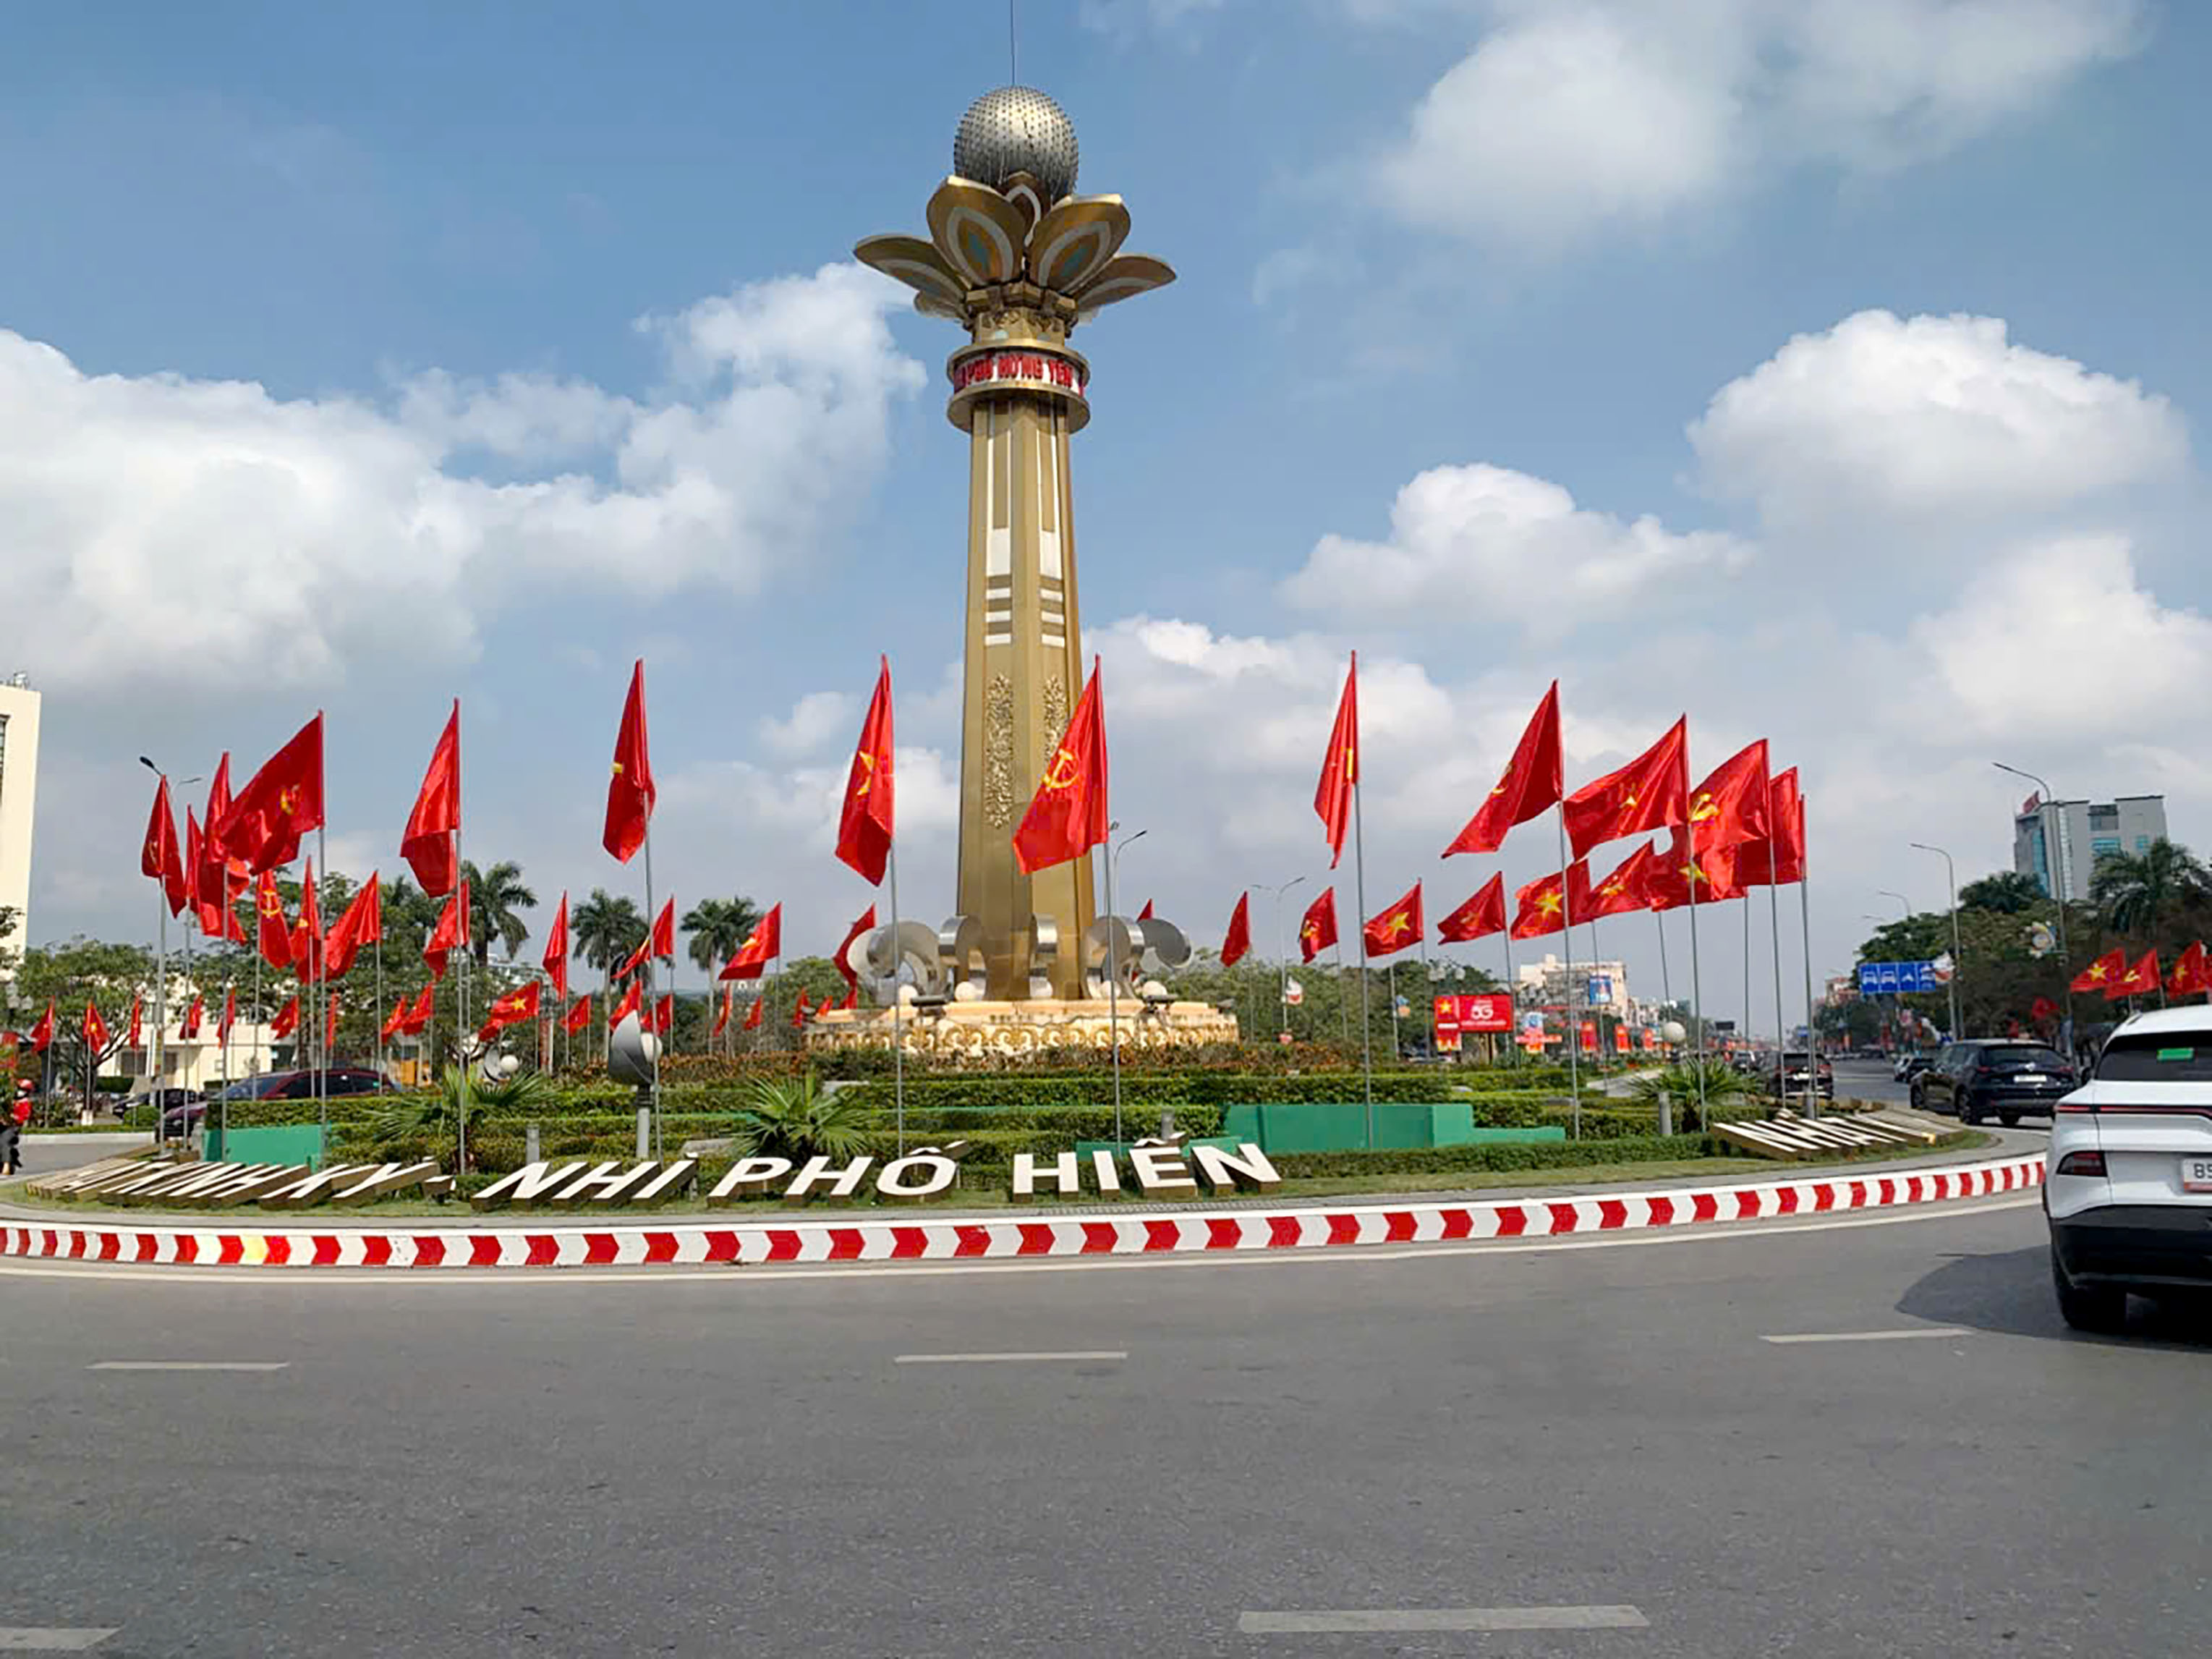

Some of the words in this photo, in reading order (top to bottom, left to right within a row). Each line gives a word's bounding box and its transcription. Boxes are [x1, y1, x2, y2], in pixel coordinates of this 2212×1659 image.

[997, 352, 1044, 379] HƯNG
[1047, 357, 1073, 389] YÊN
[99, 1161, 308, 1198] KINH
[472, 1152, 699, 1200] NHÌ
[708, 1140, 968, 1197] PHỐ
[1013, 1131, 1282, 1194] HIẾN
